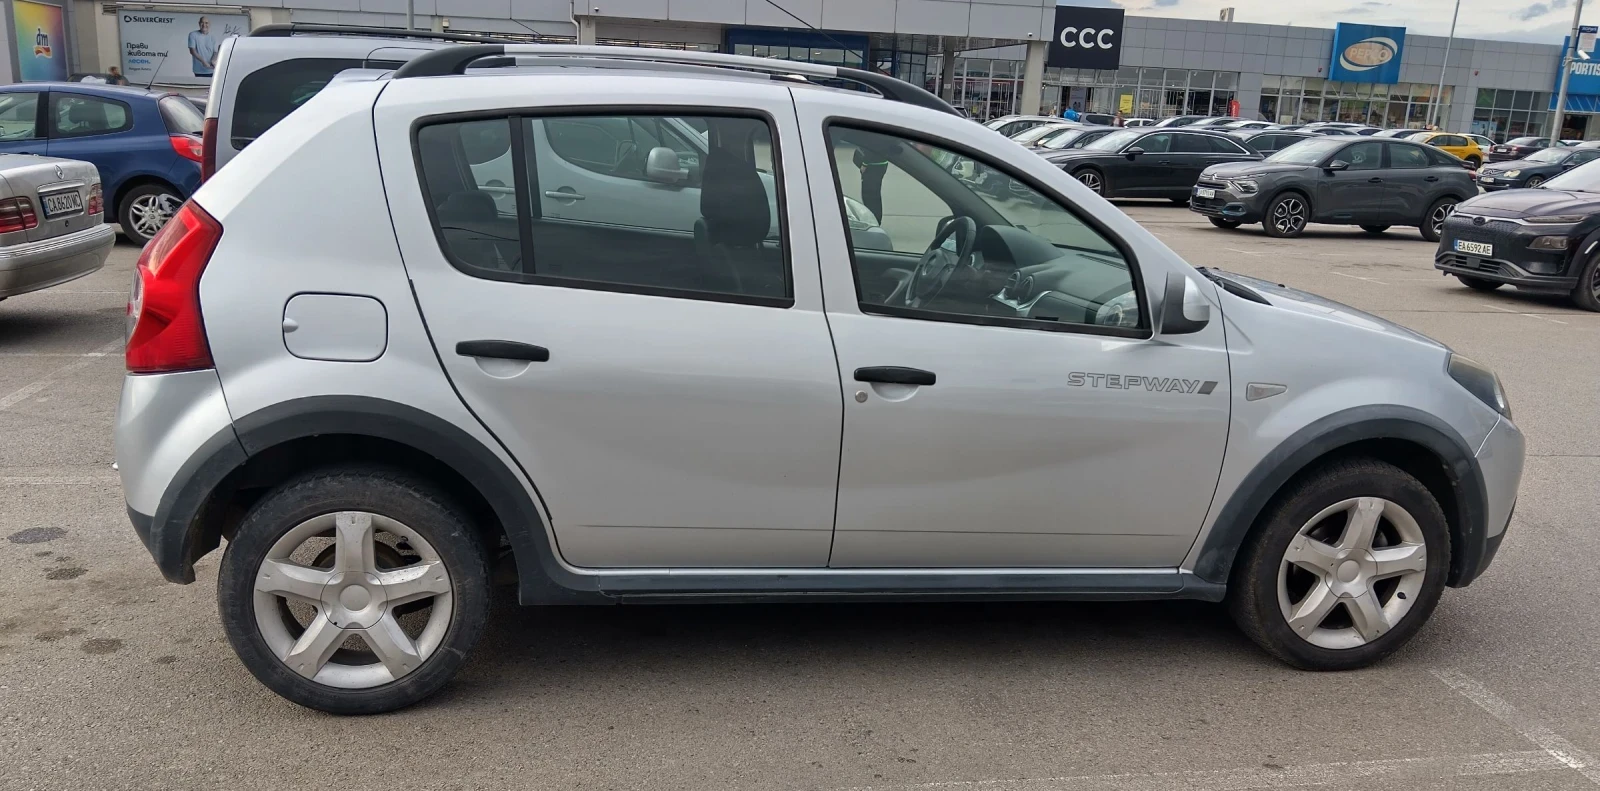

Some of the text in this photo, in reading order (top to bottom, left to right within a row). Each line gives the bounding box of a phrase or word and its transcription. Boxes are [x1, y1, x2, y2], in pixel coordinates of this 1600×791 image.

[36, 27, 49, 46] dm
[1060, 26, 1114, 49] CCC
[126, 42, 149, 50] Прави
[127, 49, 156, 57] живота
[1349, 47, 1388, 61] PEPCO
[1570, 61, 1600, 76] PORTIS
[1067, 371, 1200, 394] STEPWAY
